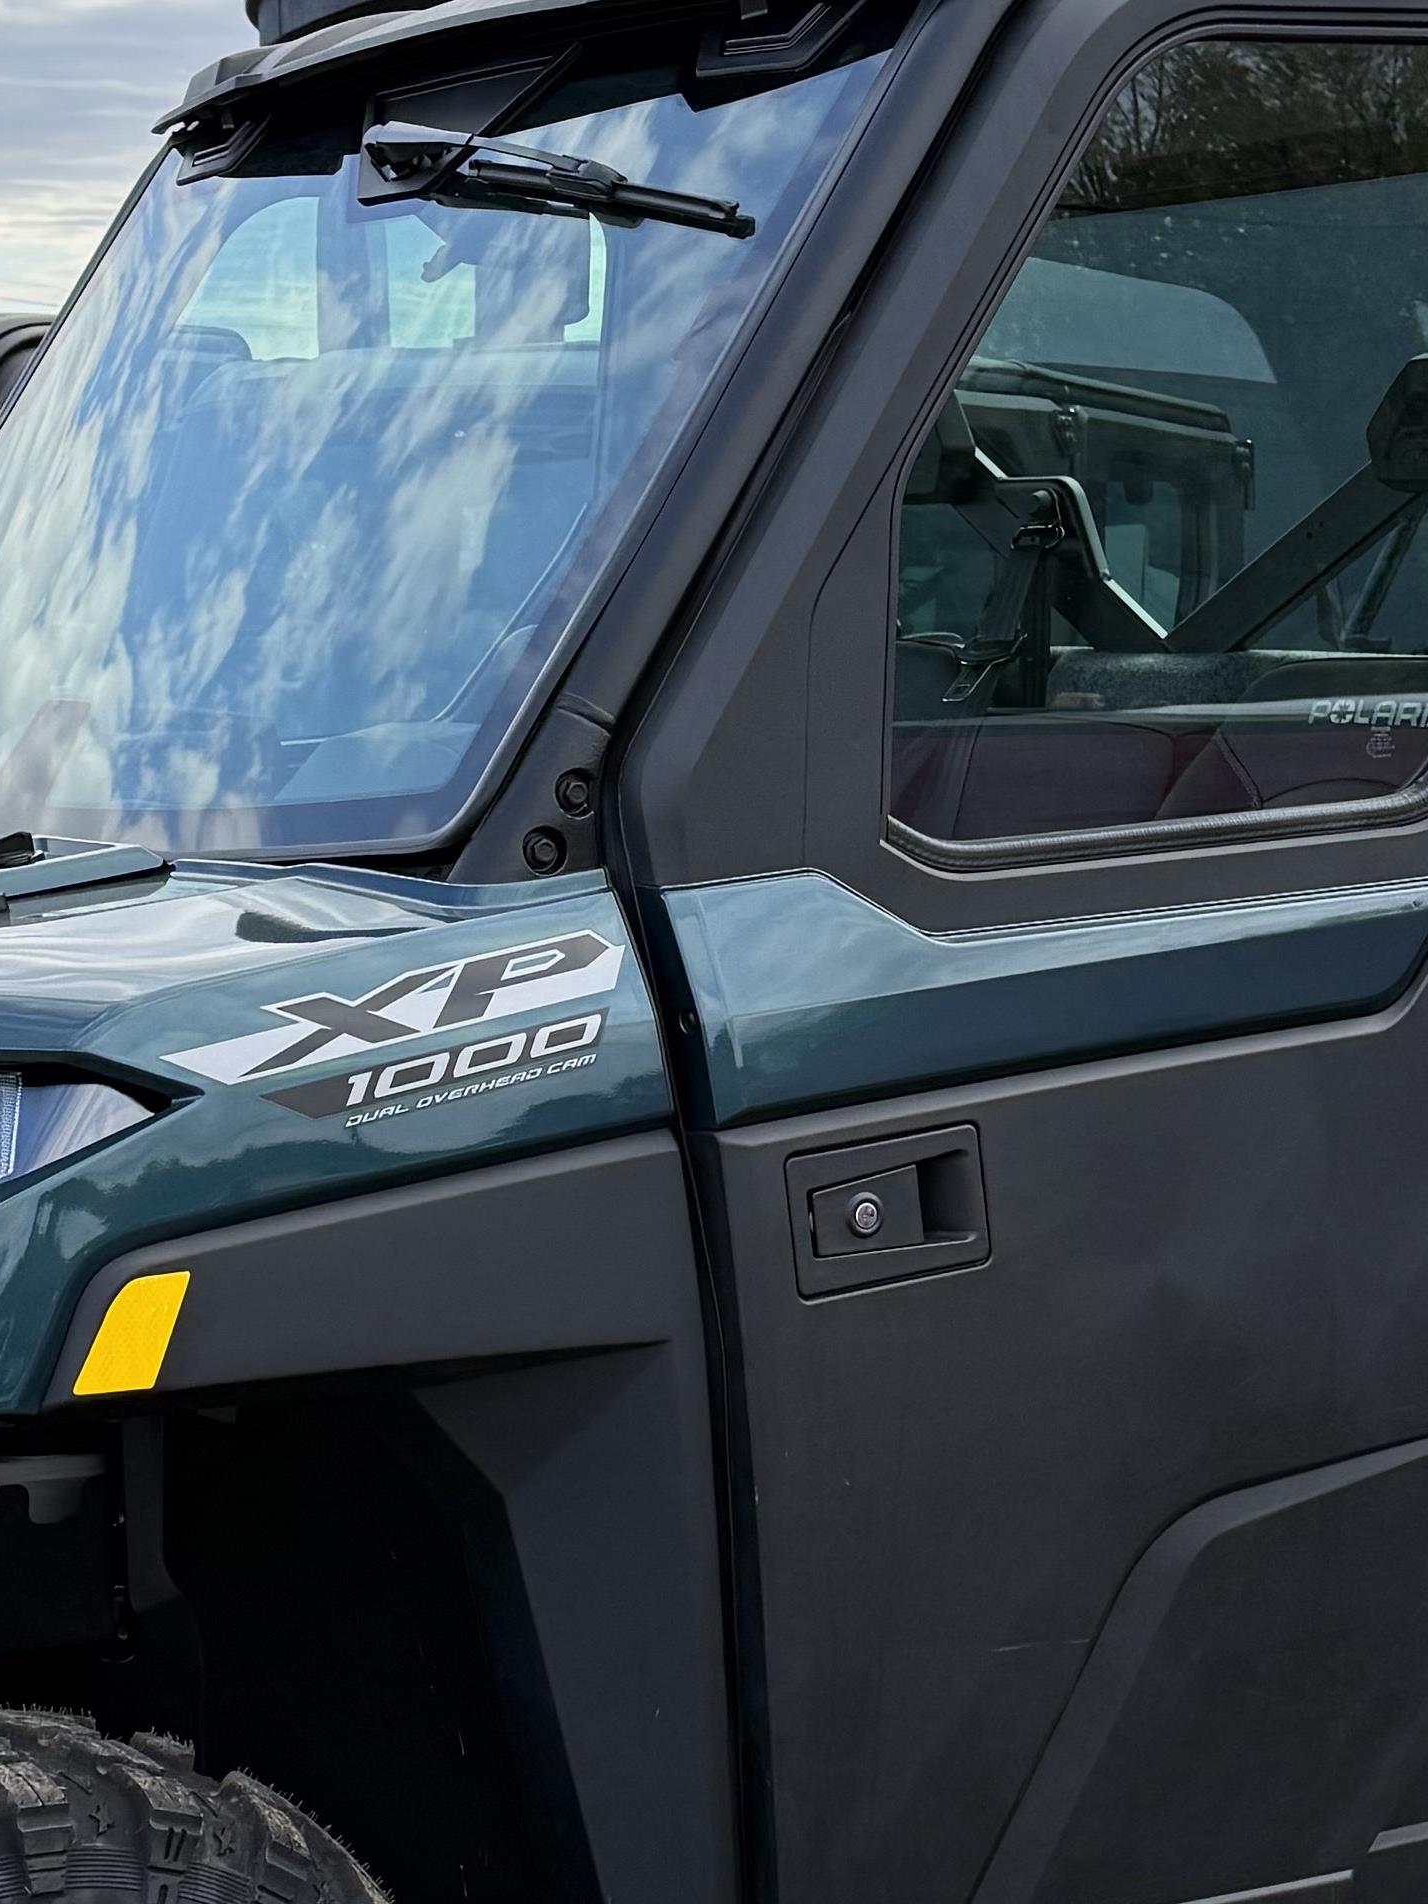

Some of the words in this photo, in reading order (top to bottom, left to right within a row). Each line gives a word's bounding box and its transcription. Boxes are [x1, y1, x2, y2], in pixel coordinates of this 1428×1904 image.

[236, 928, 611, 1080] XP
[344, 1101, 410, 1129] DUAL
[415, 1065, 543, 1109] OVERHEAD
[545, 1053, 598, 1075] CAM
[345, 1012, 603, 1108] 1000
